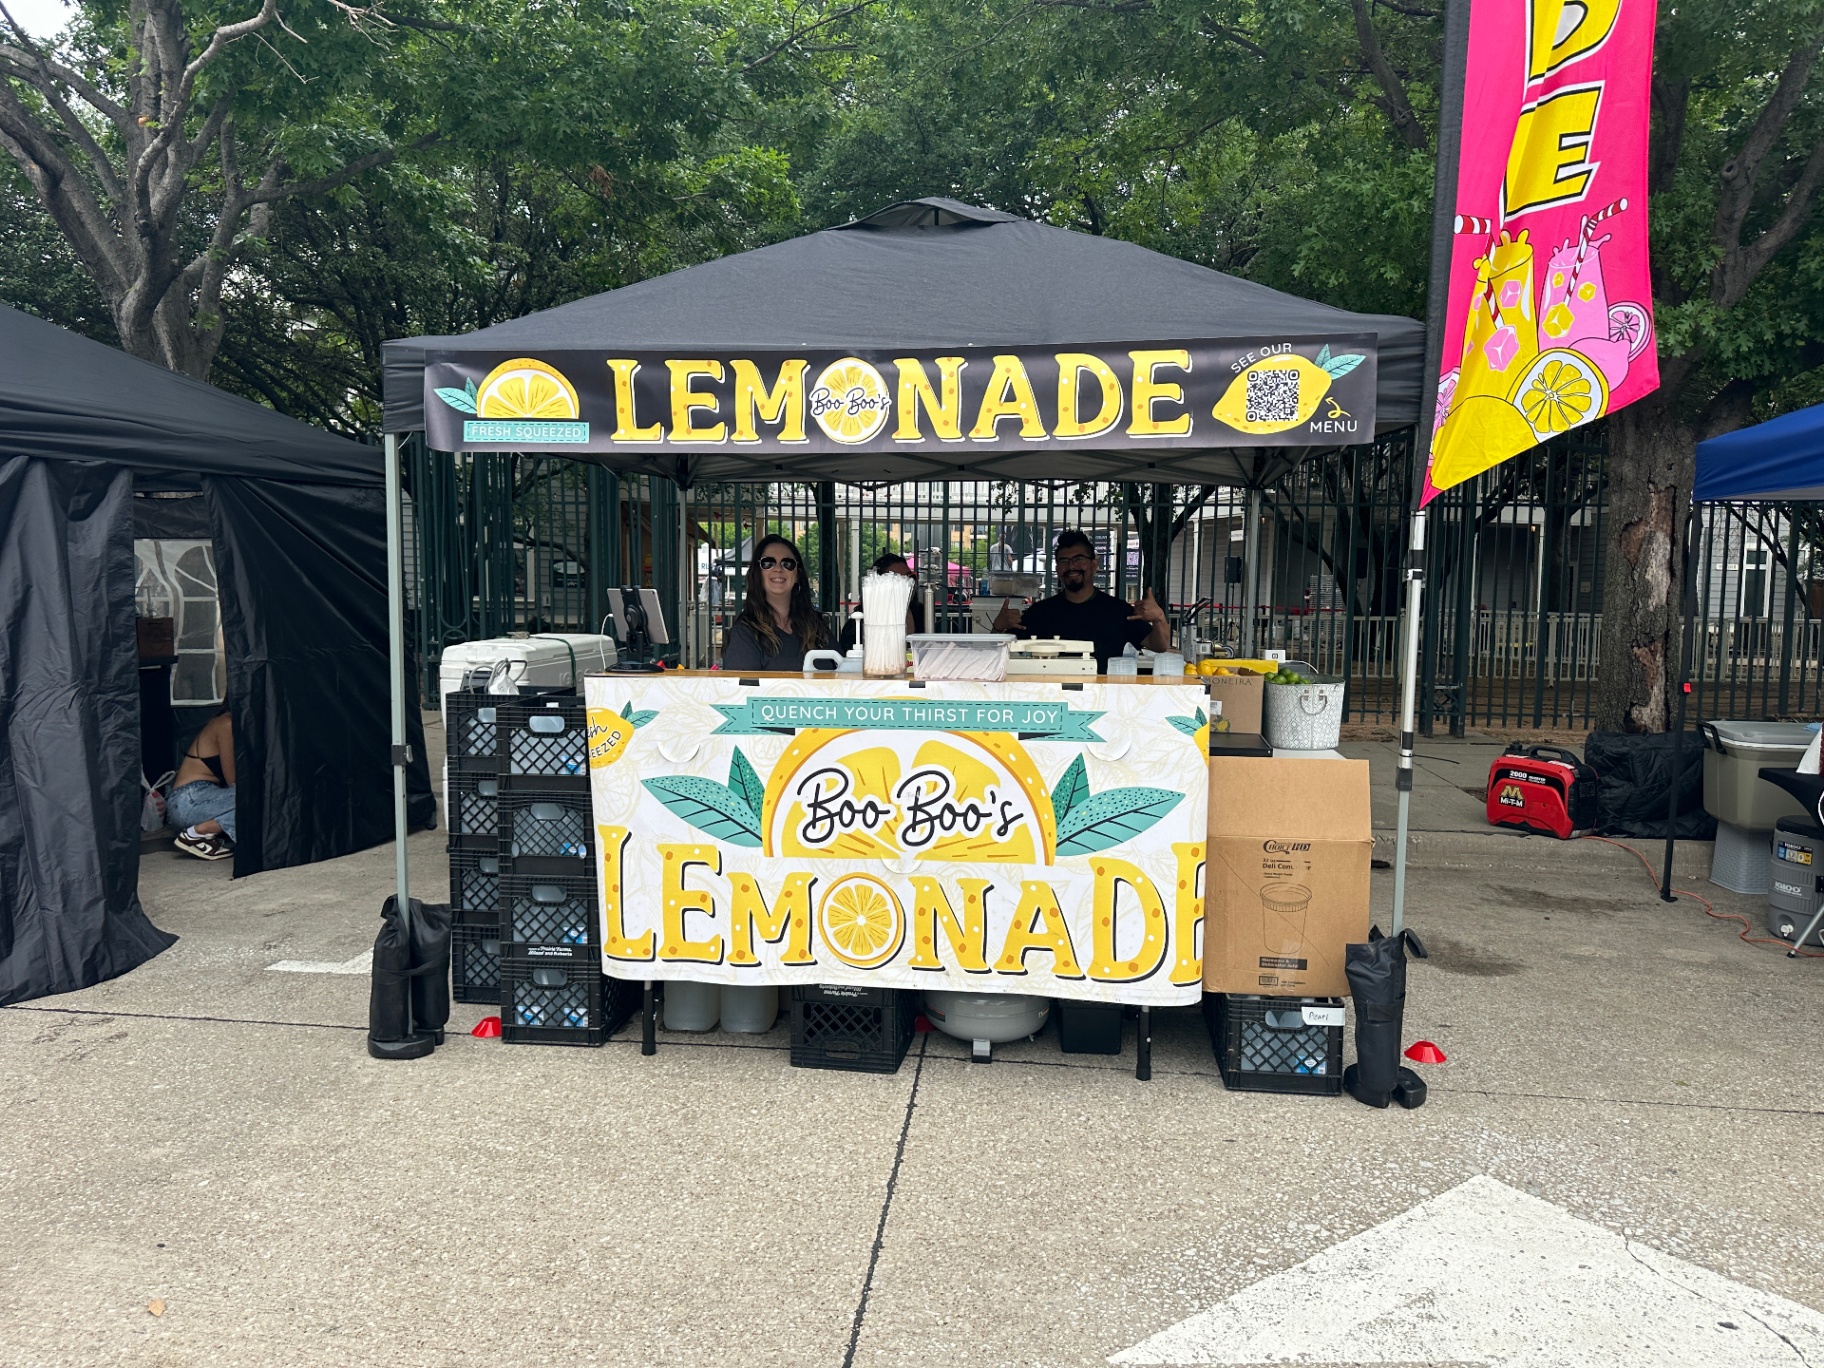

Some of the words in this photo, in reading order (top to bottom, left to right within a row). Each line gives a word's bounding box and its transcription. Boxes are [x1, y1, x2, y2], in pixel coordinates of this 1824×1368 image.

[1230, 352, 1257, 374] SEE
[1260, 343, 1292, 357] OUR
[606, 349, 1193, 445] LEMONADE
[810, 387, 845, 416] Boo
[846, 387, 890, 416] Boo's
[471, 426, 511, 437] FRESH
[515, 427, 582, 439] SQUEEZED
[1309, 420, 1358, 433] MENU
[761, 704, 837, 722] QUENCH
[844, 706, 895, 722] YOUR
[902, 707, 969, 722] THIRST
[976, 708, 1014, 723] FOR
[1021, 709, 1059, 724] JOY
[1509, 770, 1527, 779] 2000
[797, 768, 891, 844] Boo
[896, 769, 1024, 847] Boo's
